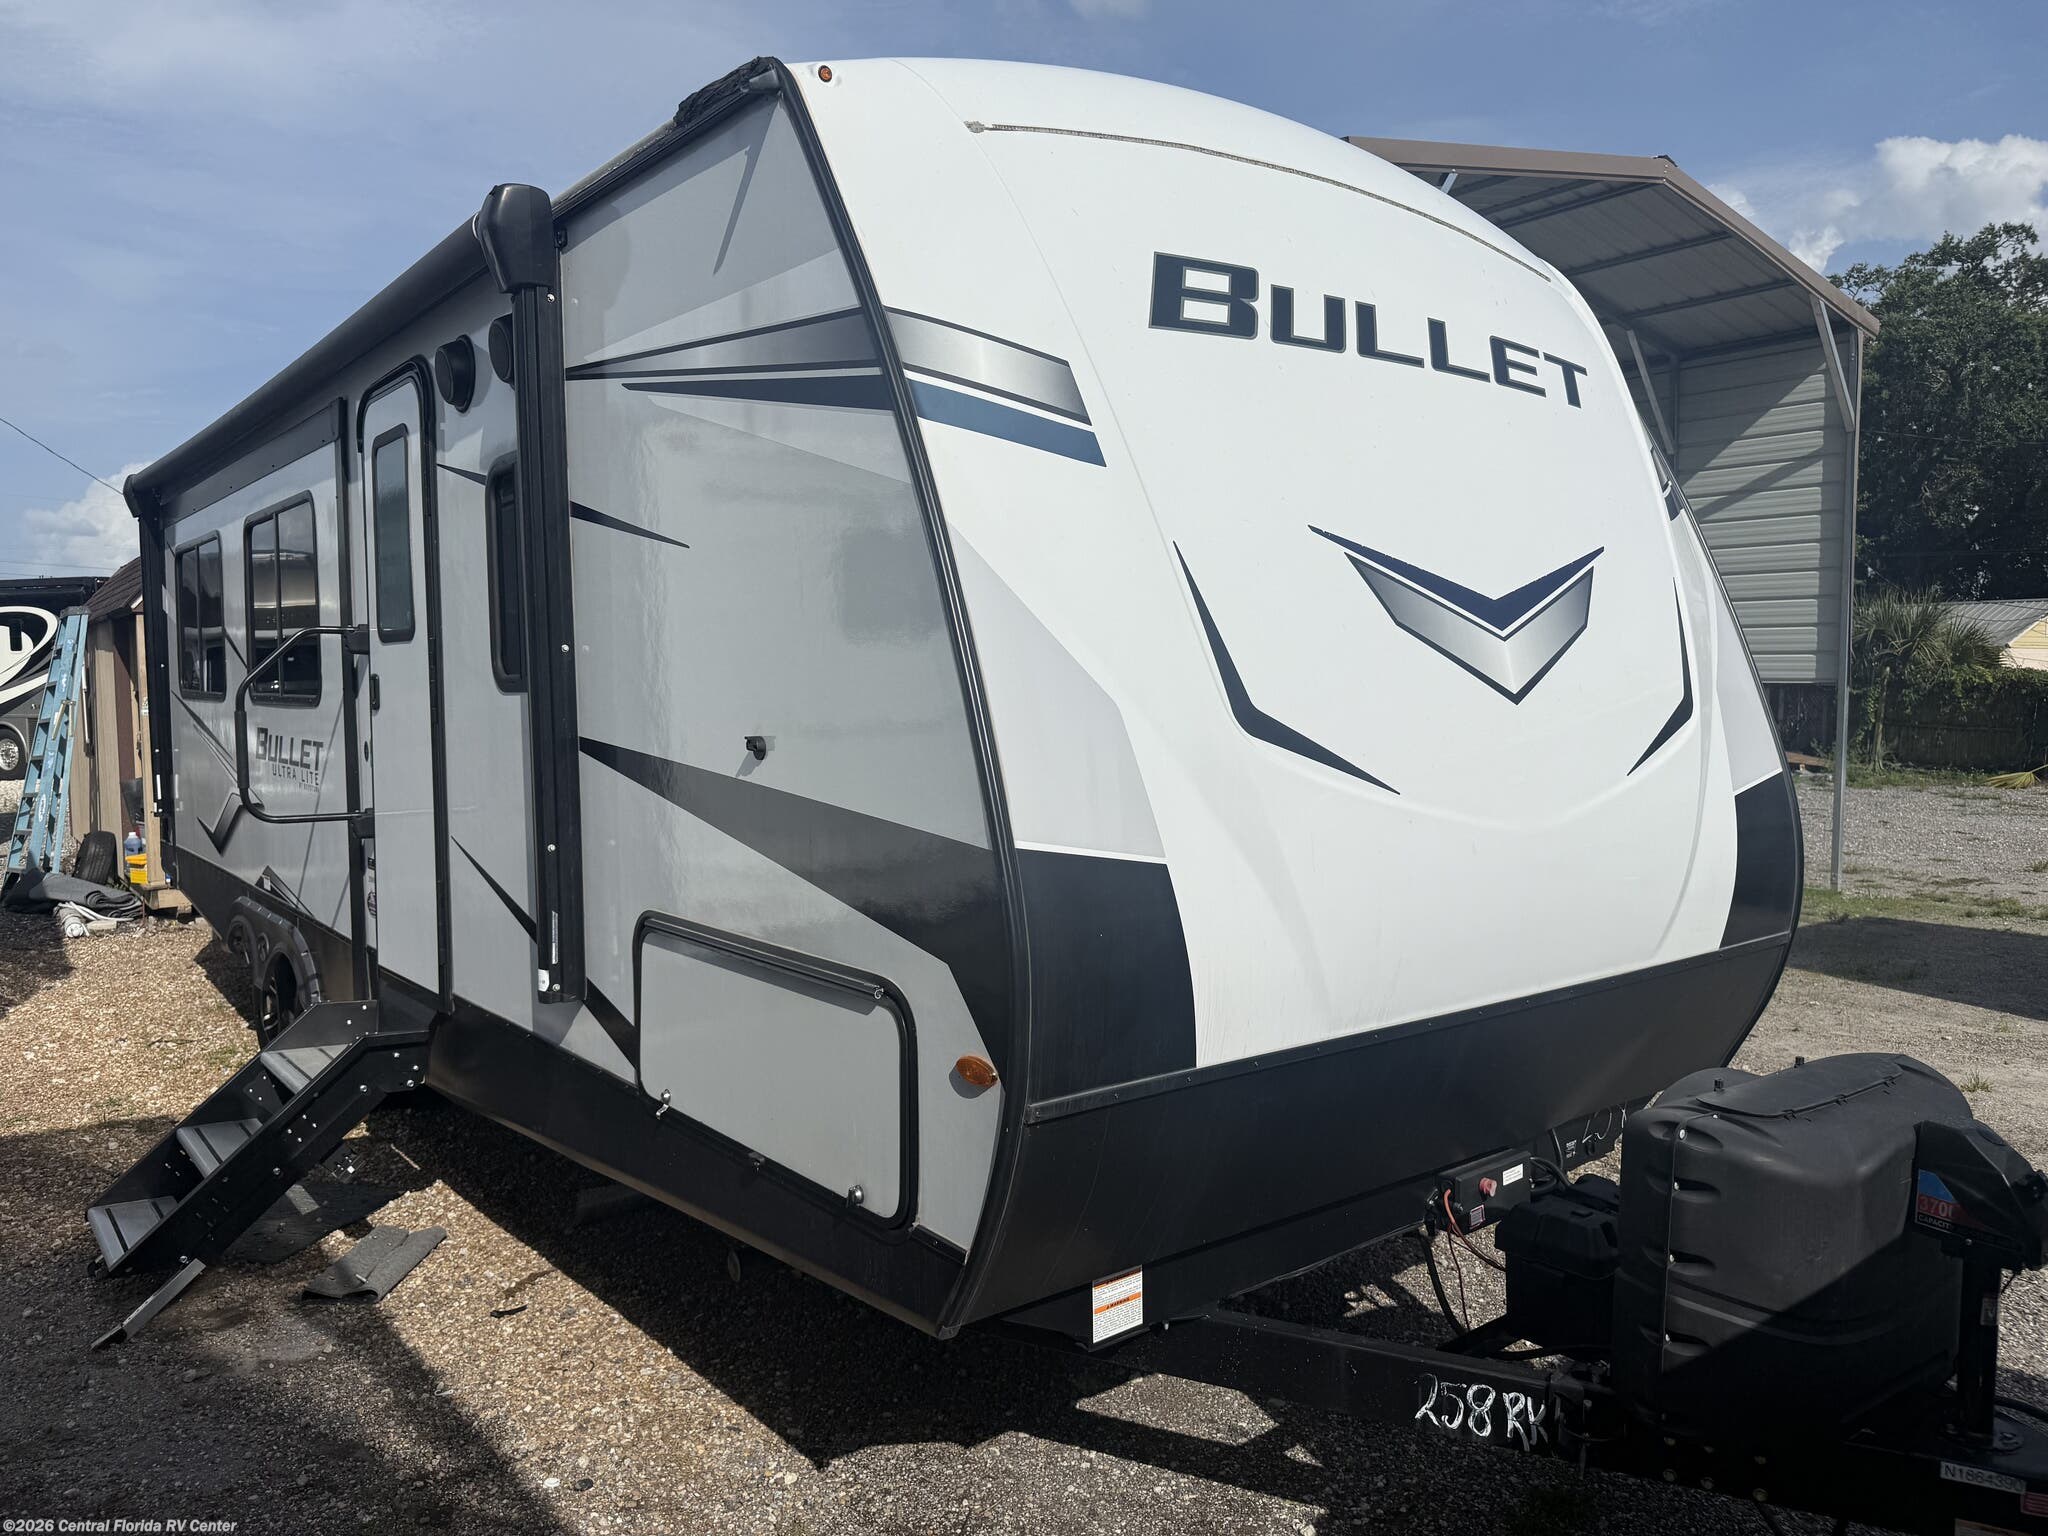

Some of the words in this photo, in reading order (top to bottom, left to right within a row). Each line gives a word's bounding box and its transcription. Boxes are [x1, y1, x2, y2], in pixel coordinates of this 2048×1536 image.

[1148, 251, 1588, 408] BULLET
[256, 727, 324, 771] BULLET
[272, 764, 296, 780] ULTRA
[301, 769, 319, 786] LITE
[1414, 1373, 1496, 1438] 258
[1502, 1391, 1549, 1451] RK
